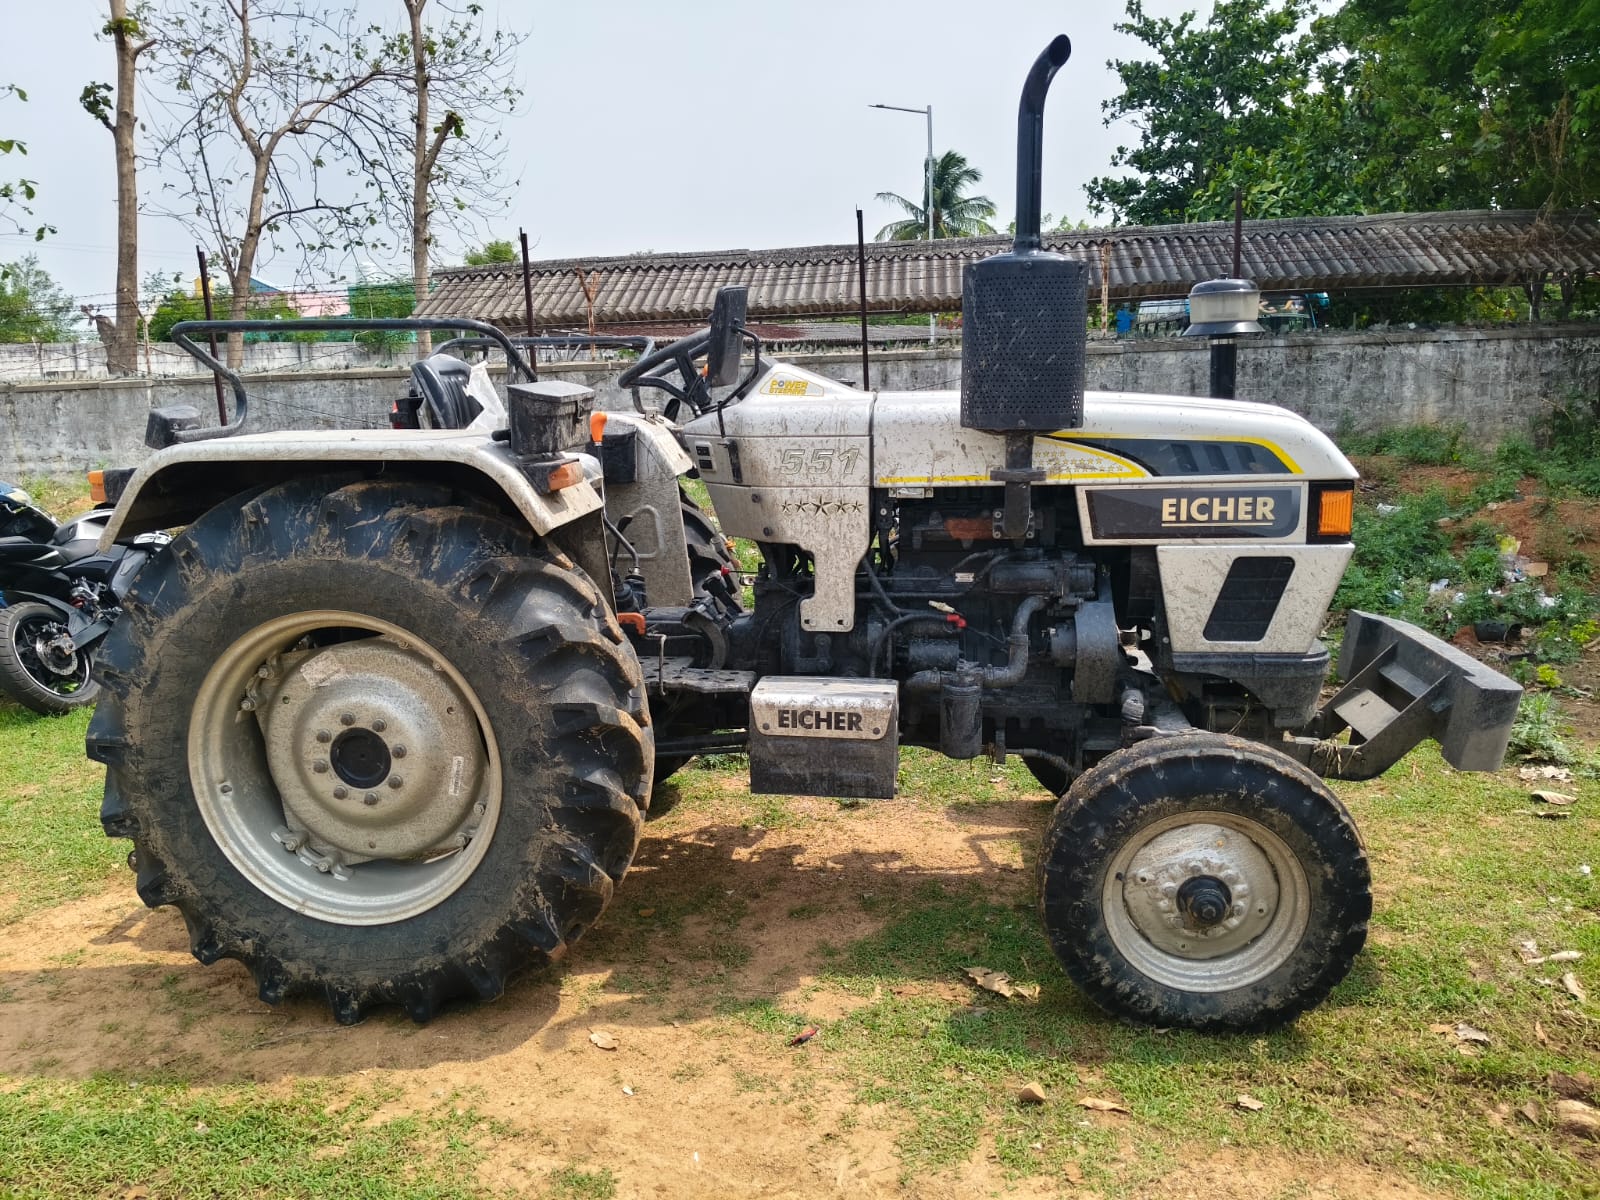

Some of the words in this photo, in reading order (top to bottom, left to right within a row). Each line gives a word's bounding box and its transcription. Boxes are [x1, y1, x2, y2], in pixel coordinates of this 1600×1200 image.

[770, 379, 808, 389] POWER
[780, 448, 860, 475] 551
[1161, 497, 1276, 522] EICHER
[777, 709, 864, 732] EICHER
